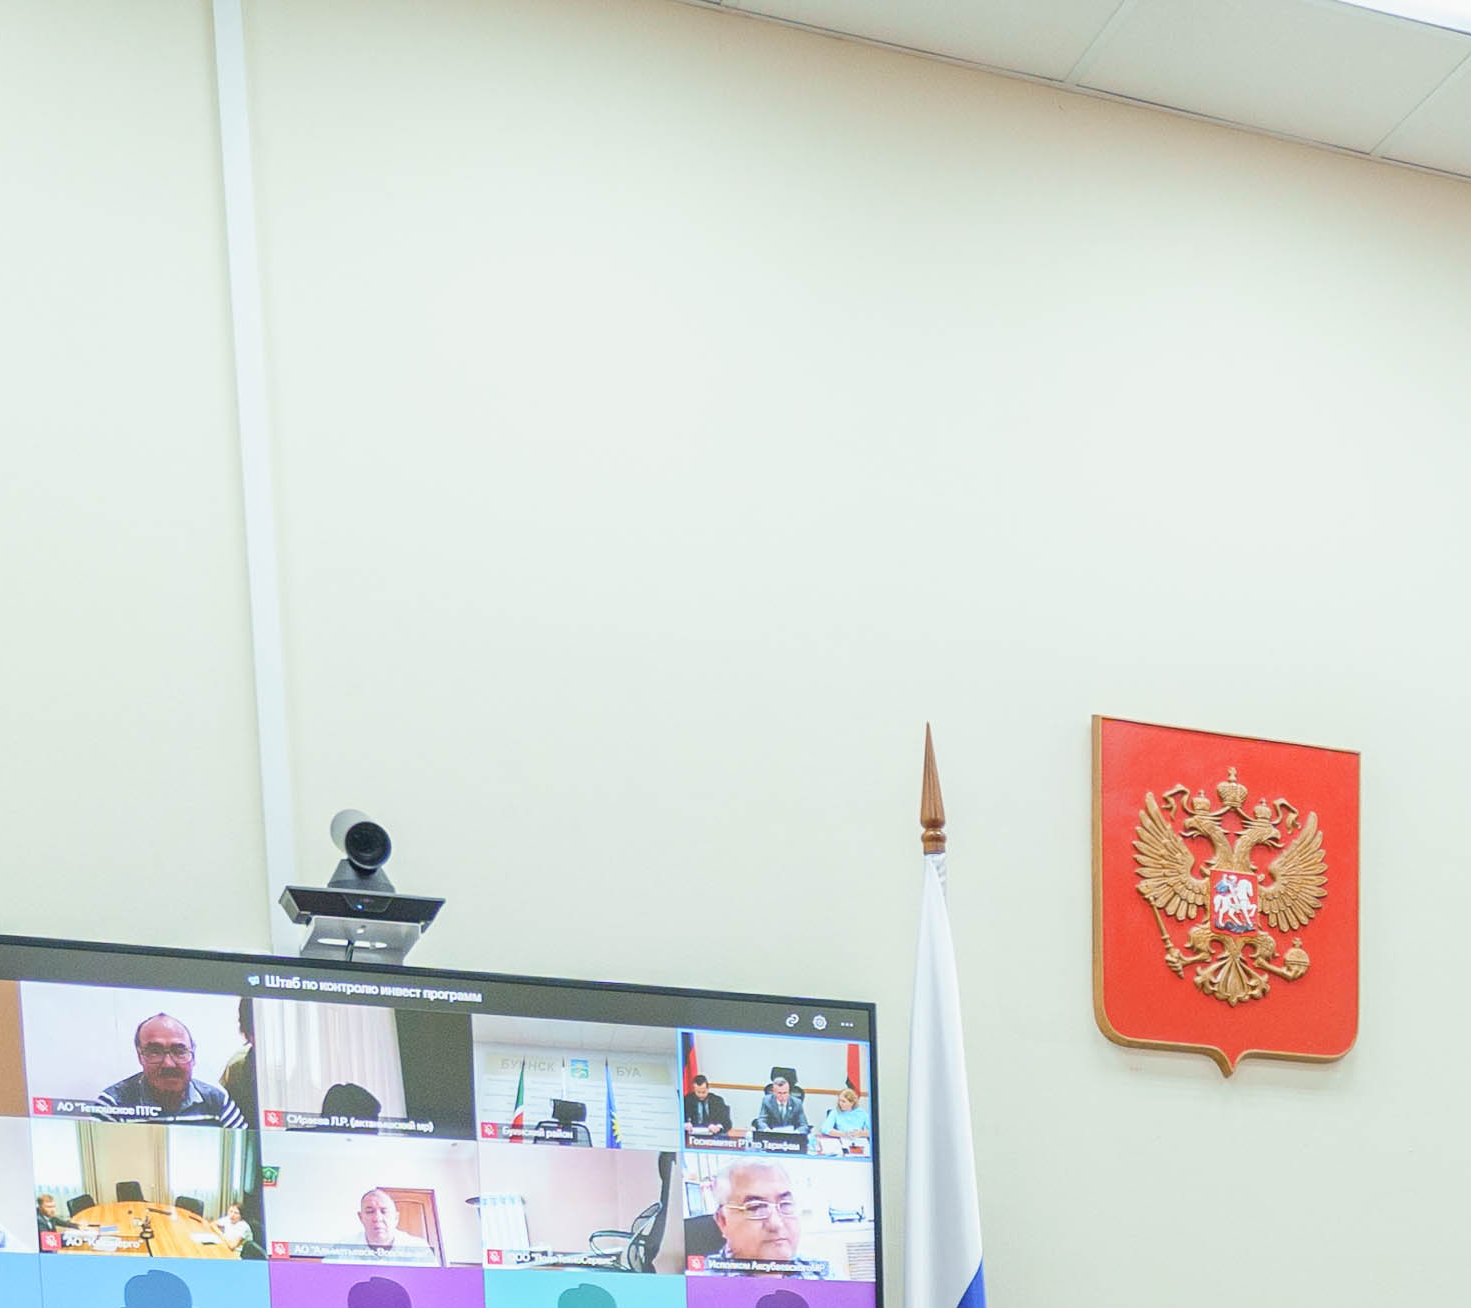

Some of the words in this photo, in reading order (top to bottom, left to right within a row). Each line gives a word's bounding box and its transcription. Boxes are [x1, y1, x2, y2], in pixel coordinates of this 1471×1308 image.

[265, 975, 300, 990] Штаб
[303, 979, 318, 992] по
[320, 981, 378, 996] контролю
[380, 985, 420, 998] инвест
[423, 988, 482, 1003] программ
[57, 1100, 74, 1112] АО
[545, 1128, 574, 1141] район
